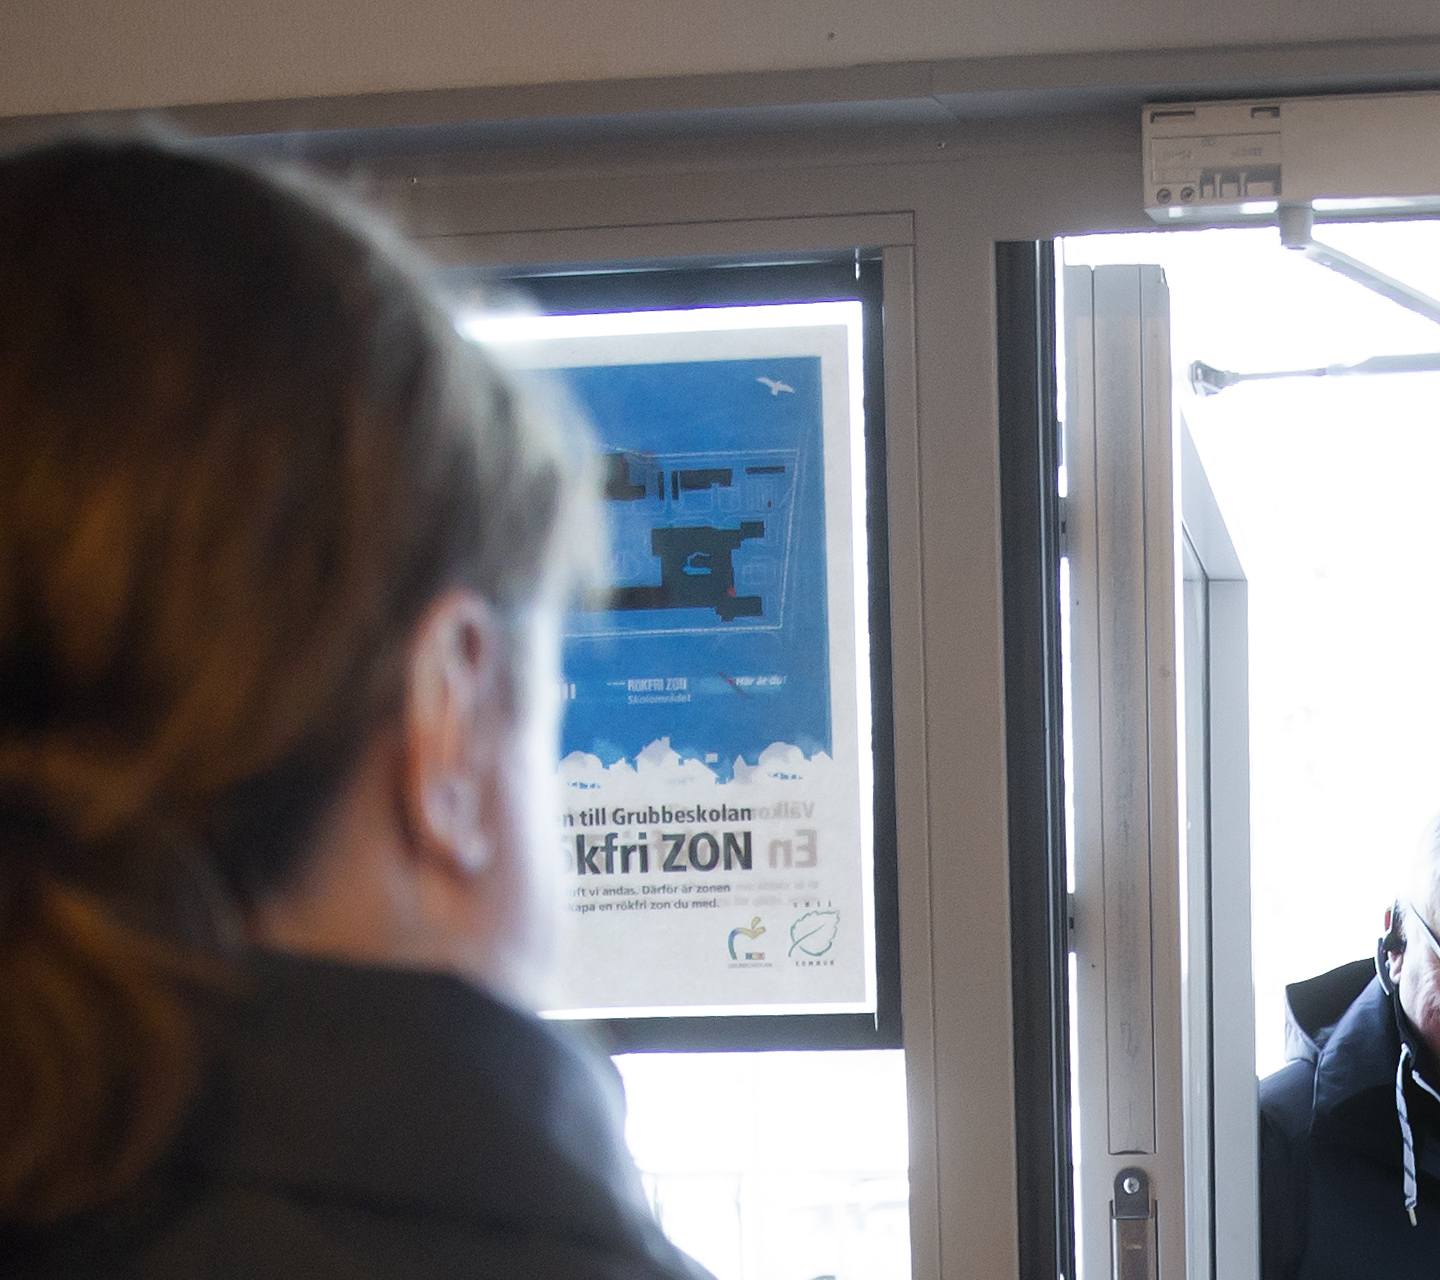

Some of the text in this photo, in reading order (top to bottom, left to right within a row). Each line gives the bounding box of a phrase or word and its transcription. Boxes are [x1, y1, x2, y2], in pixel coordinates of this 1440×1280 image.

[579, 807, 606, 827] till
[612, 804, 752, 826] Grubbeskolan
[661, 831, 753, 873] ZON
[588, 886, 600, 897] vi
[602, 885, 639, 897] andas.
[696, 883, 731, 894] zonen
[598, 903, 613, 912] en
[616, 899, 648, 912] rökfri
[650, 899, 671, 910] zon
[673, 898, 689, 909] du
[691, 897, 720, 909] med.
